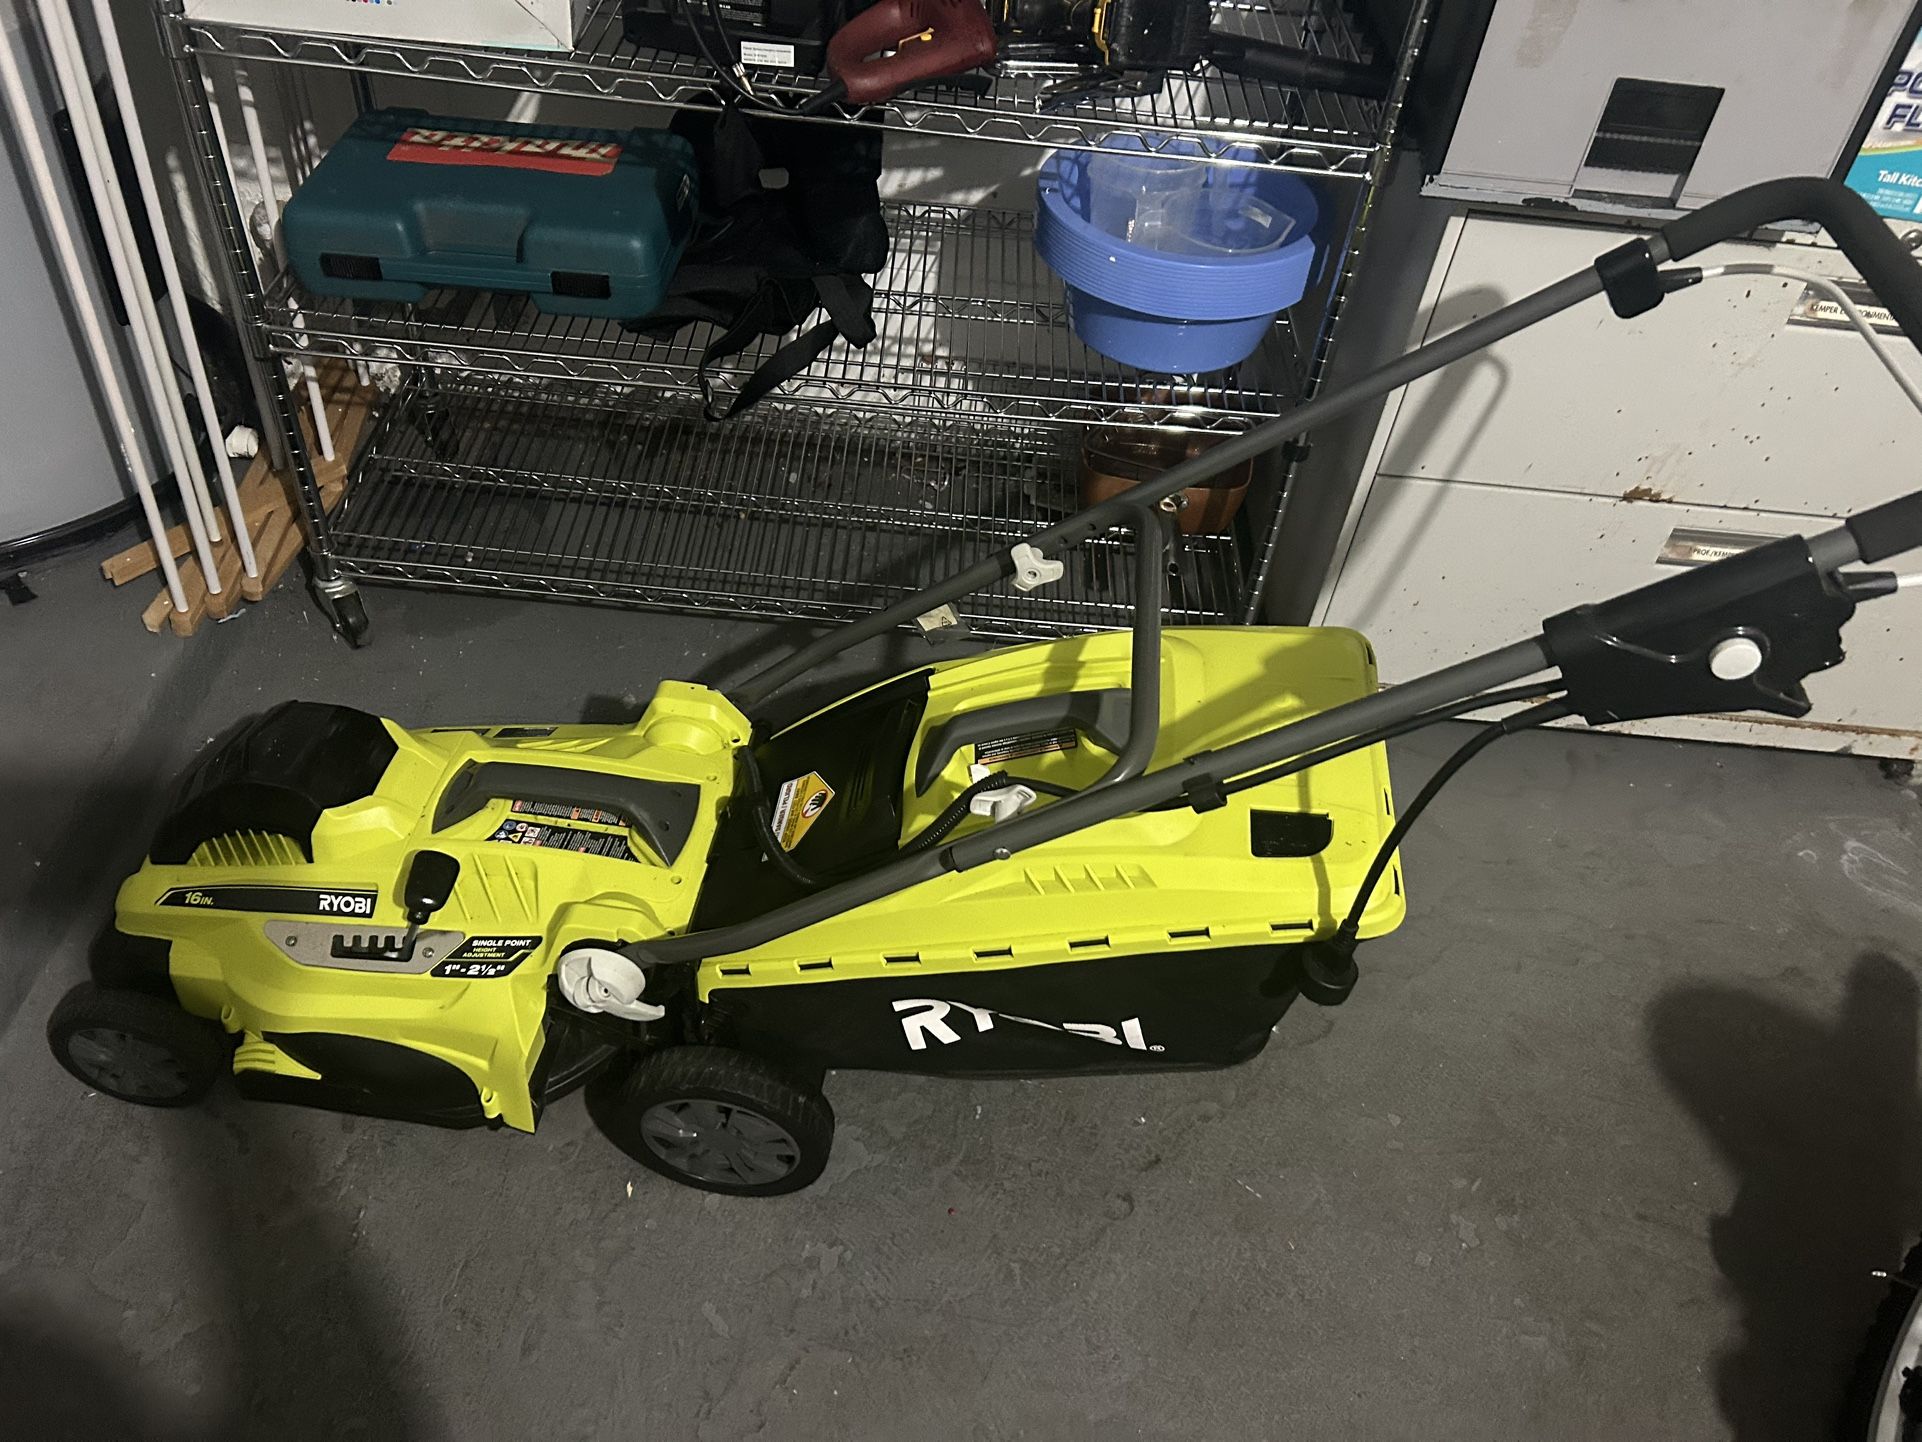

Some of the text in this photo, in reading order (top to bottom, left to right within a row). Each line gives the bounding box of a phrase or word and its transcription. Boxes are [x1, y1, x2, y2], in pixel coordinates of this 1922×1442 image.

[1884, 103, 1922, 132] FL
[1878, 169, 1900, 184] Tall
[1811, 303, 1838, 315] KEMPER
[319, 894, 371, 914] RYOBI
[472, 939, 532, 947] SINGLE POINT
